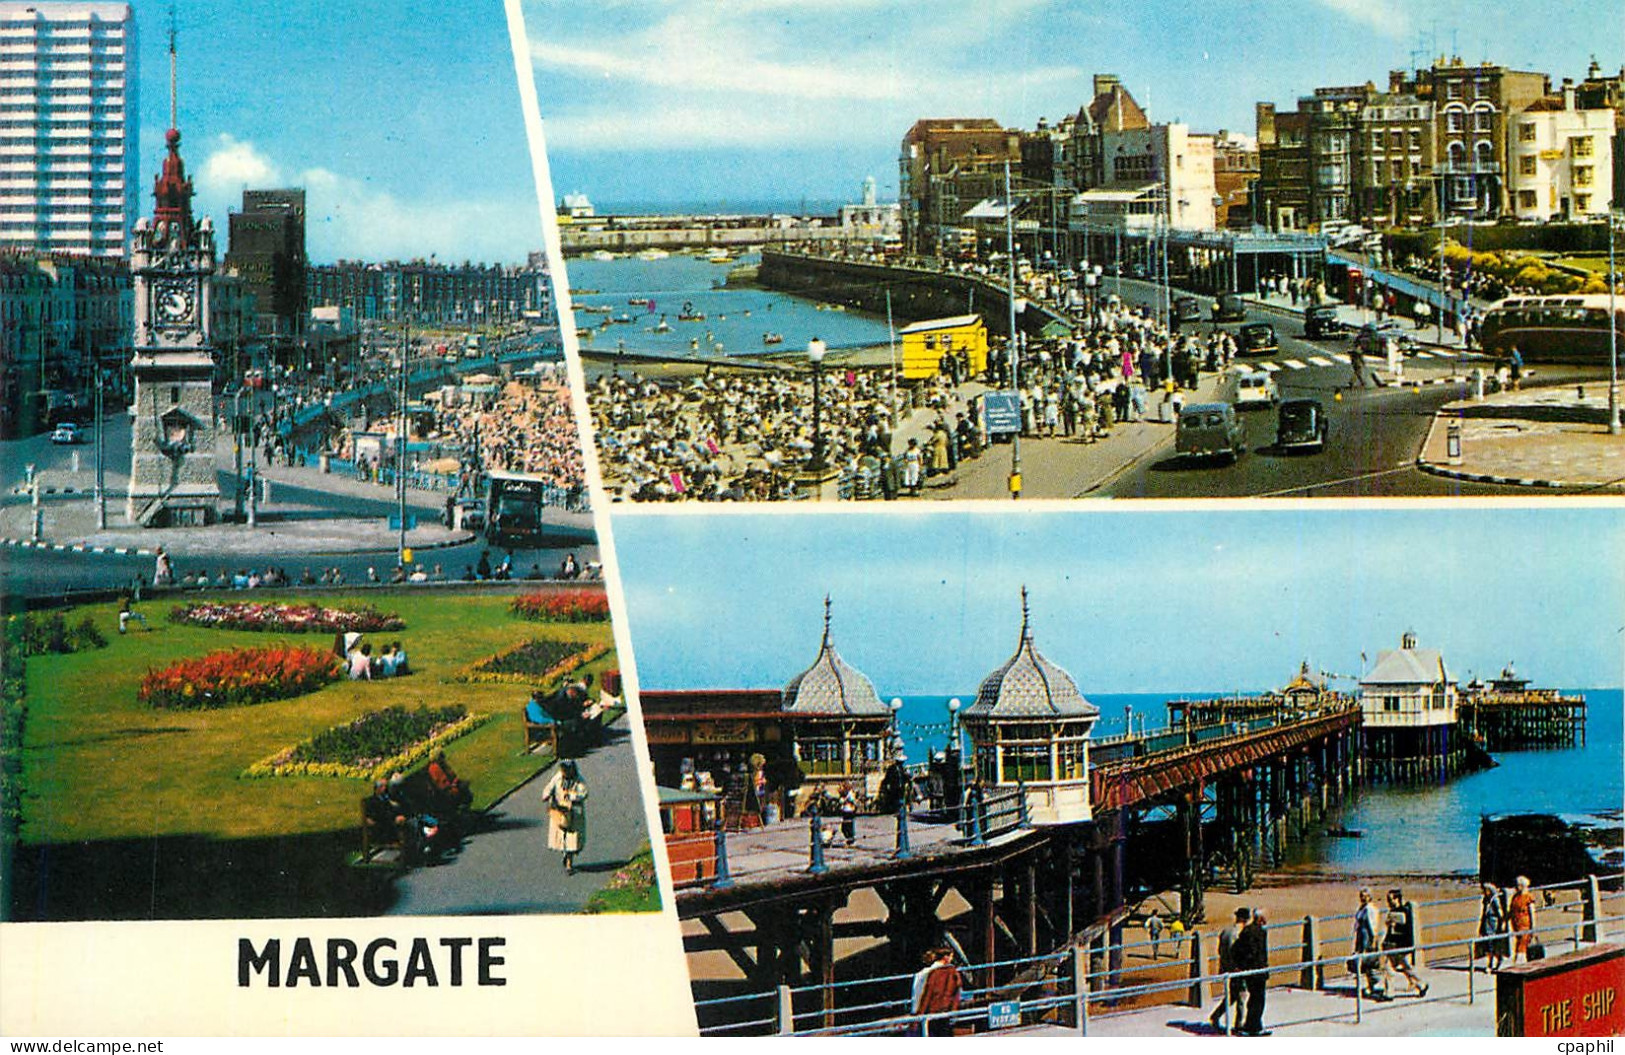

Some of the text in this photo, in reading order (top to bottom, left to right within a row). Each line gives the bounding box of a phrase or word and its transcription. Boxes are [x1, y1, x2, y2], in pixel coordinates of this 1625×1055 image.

[238, 937, 507, 987] MARGATE
[1540, 987, 1615, 1035] THE SHIP
